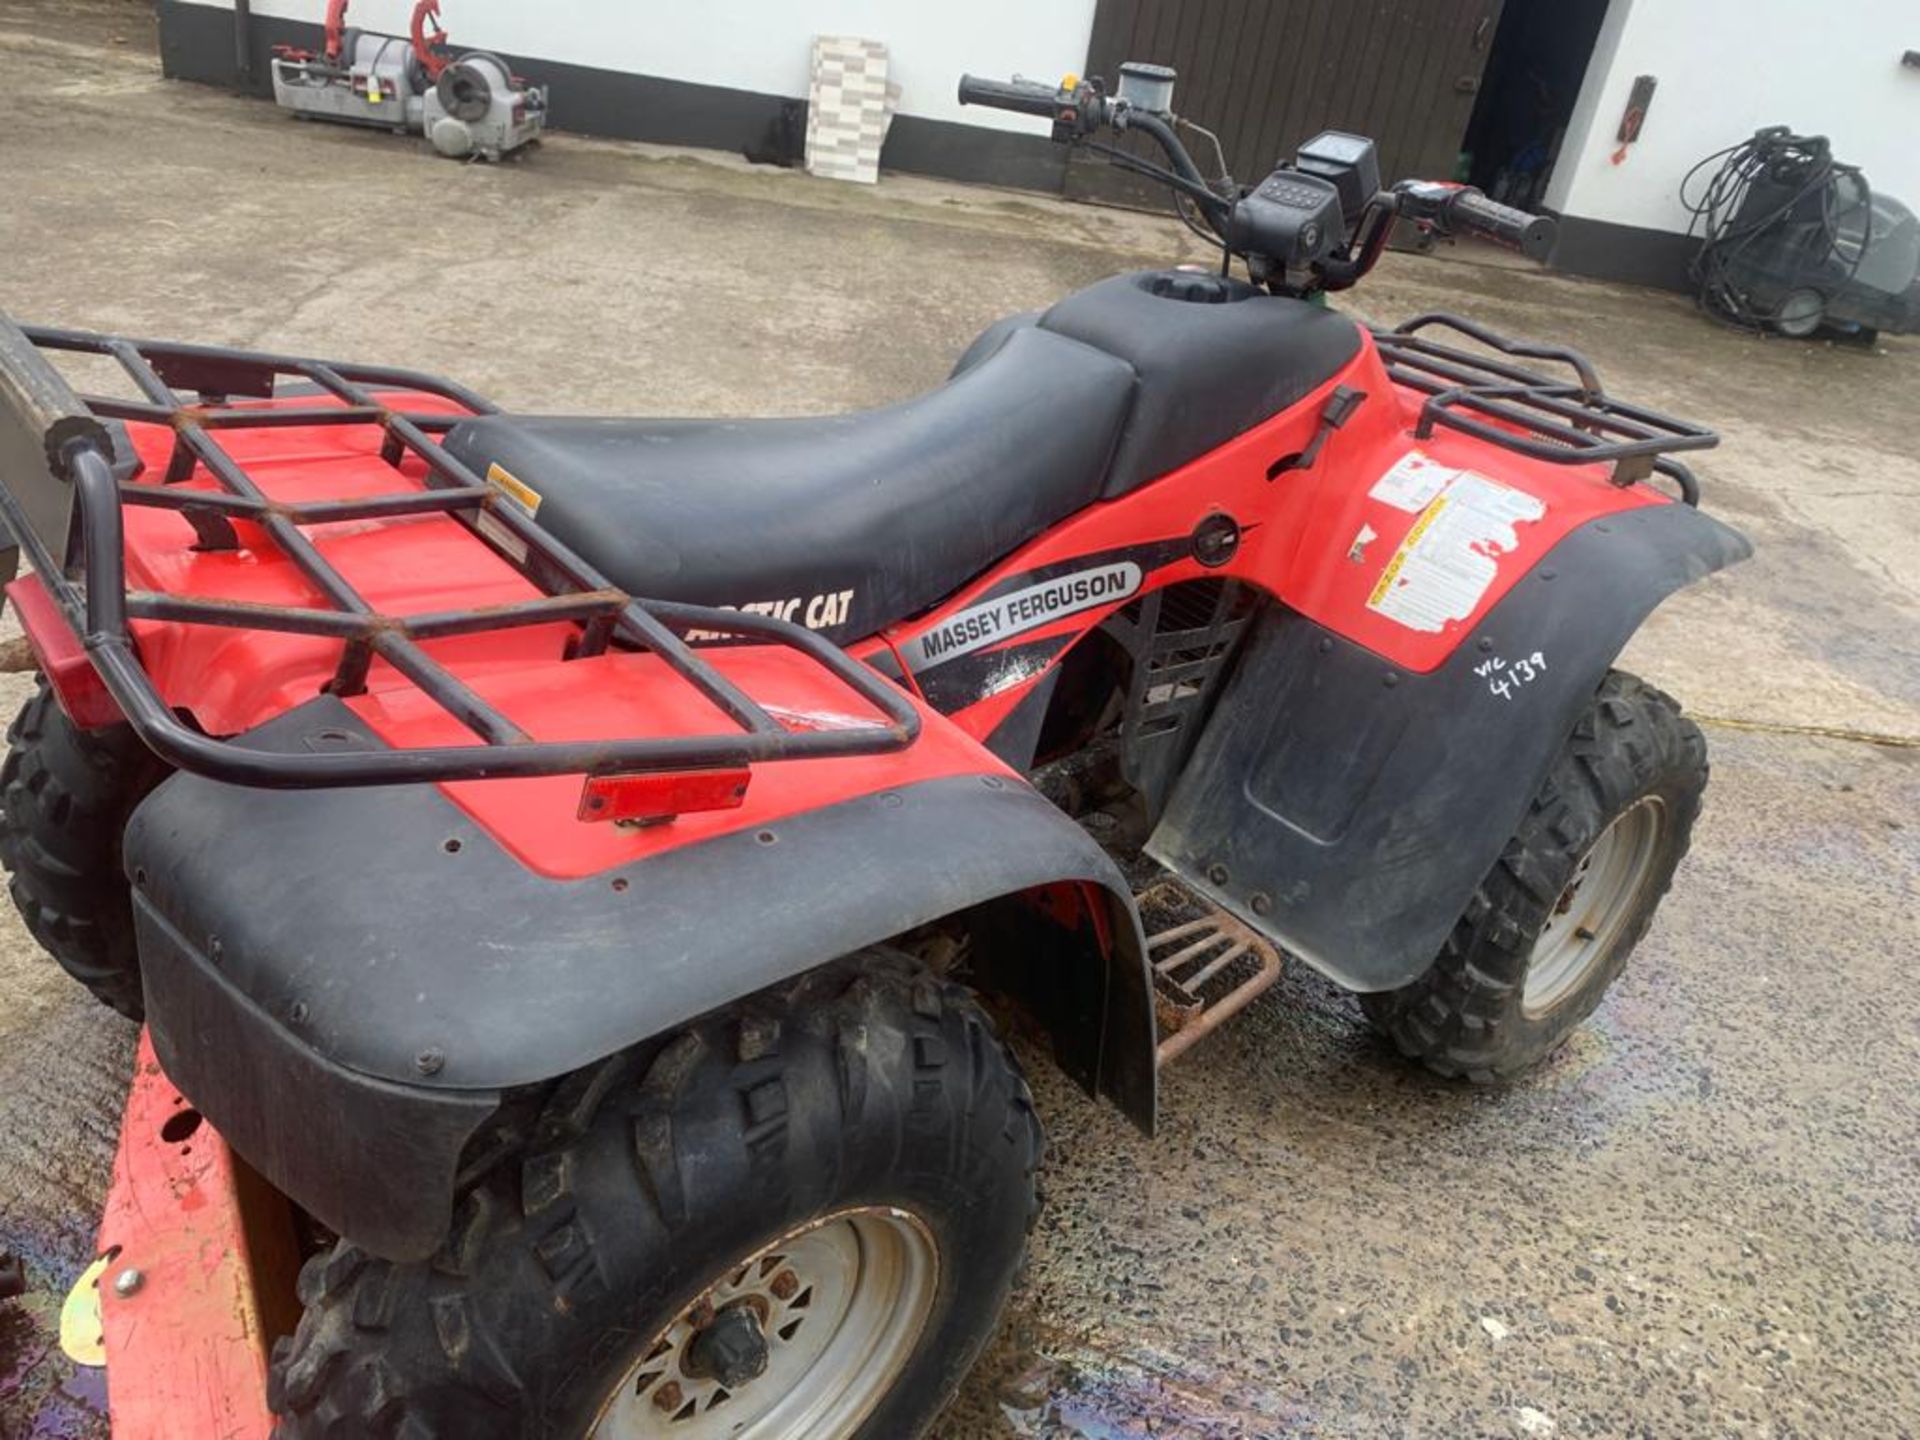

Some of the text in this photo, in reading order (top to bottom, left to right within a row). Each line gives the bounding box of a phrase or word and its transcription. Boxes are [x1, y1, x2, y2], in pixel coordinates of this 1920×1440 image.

[684, 590, 854, 642] TIC CAT
[921, 571, 1126, 659] MASSEY FERGUSON
[1489, 651, 1547, 701] 4139
